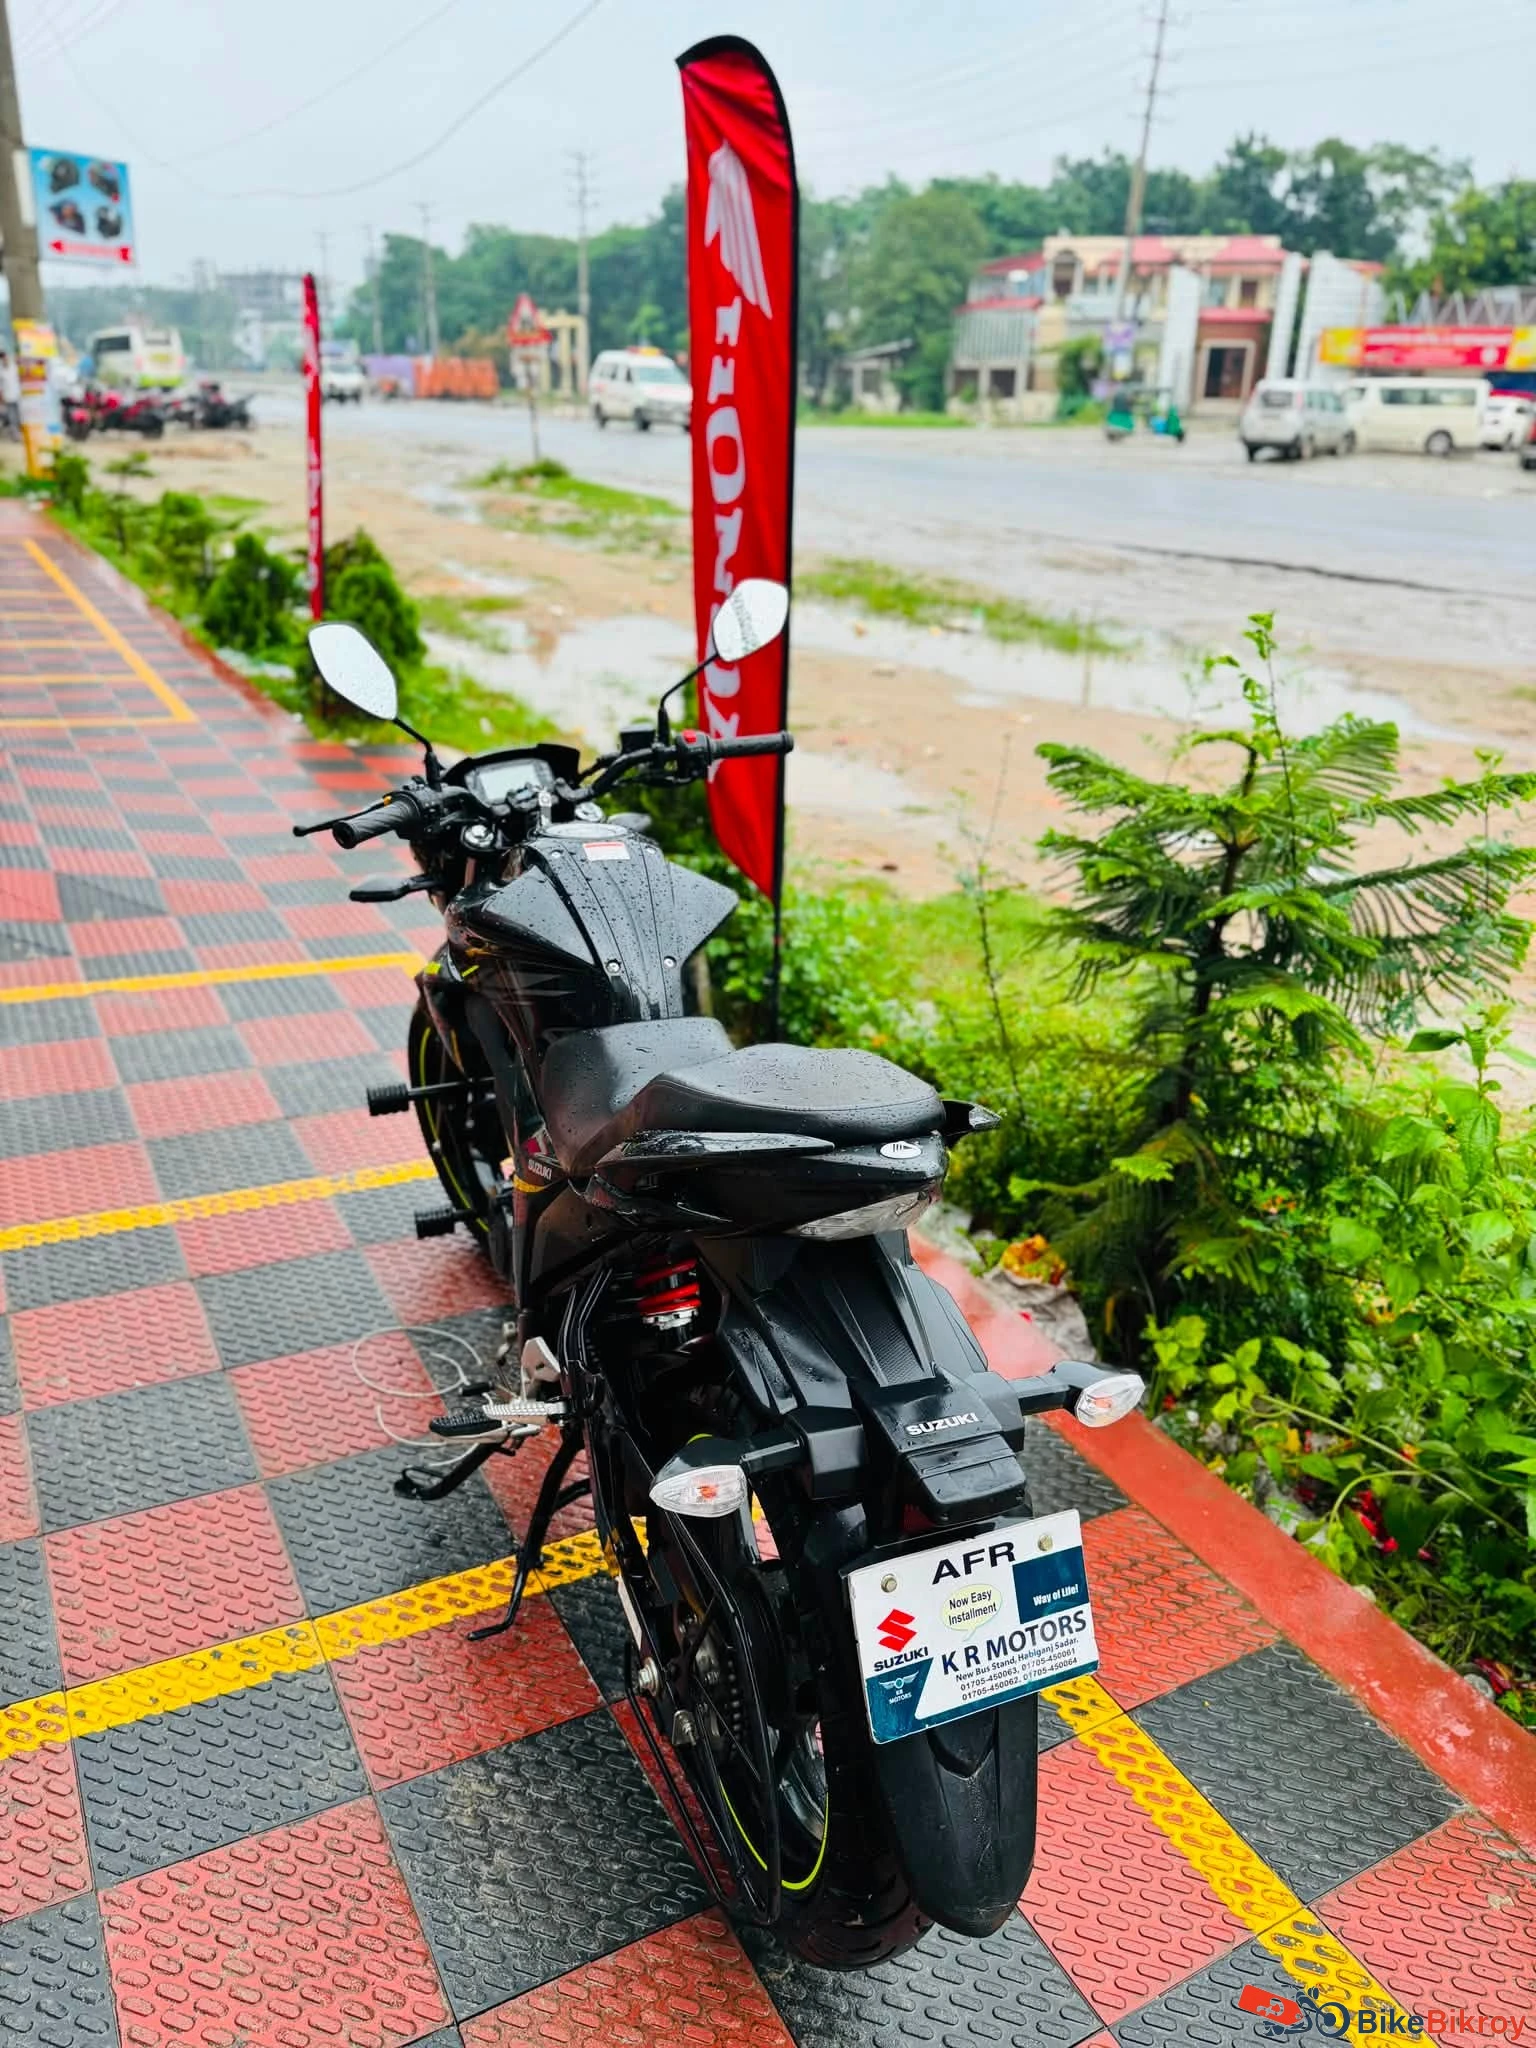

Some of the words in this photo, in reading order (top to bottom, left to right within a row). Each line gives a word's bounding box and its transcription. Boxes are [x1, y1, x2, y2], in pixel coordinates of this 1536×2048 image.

[528, 1159, 553, 1181] SUZUKI
[906, 1412, 980, 1436] SUZUKI
[932, 1541, 1016, 1585] AFR
[949, 1597, 969, 1610] Now
[970, 1589, 992, 1603] Easy
[1033, 1593, 1051, 1606] Way
[1052, 1589, 1061, 1600] of
[1061, 1583, 1079, 1597] Life!
[948, 1602, 997, 1625] Installment
[942, 1650, 960, 1675] K
[964, 1645, 981, 1668] R
[986, 1609, 1087, 1661] MOTORS
[874, 1646, 929, 1672] SUZUKI
[956, 1671, 974, 1682] New
[975, 1665, 991, 1676] Bus
[1018, 1644, 1054, 1661] Habiganj
[888, 1692, 912, 1705] MOTORS
